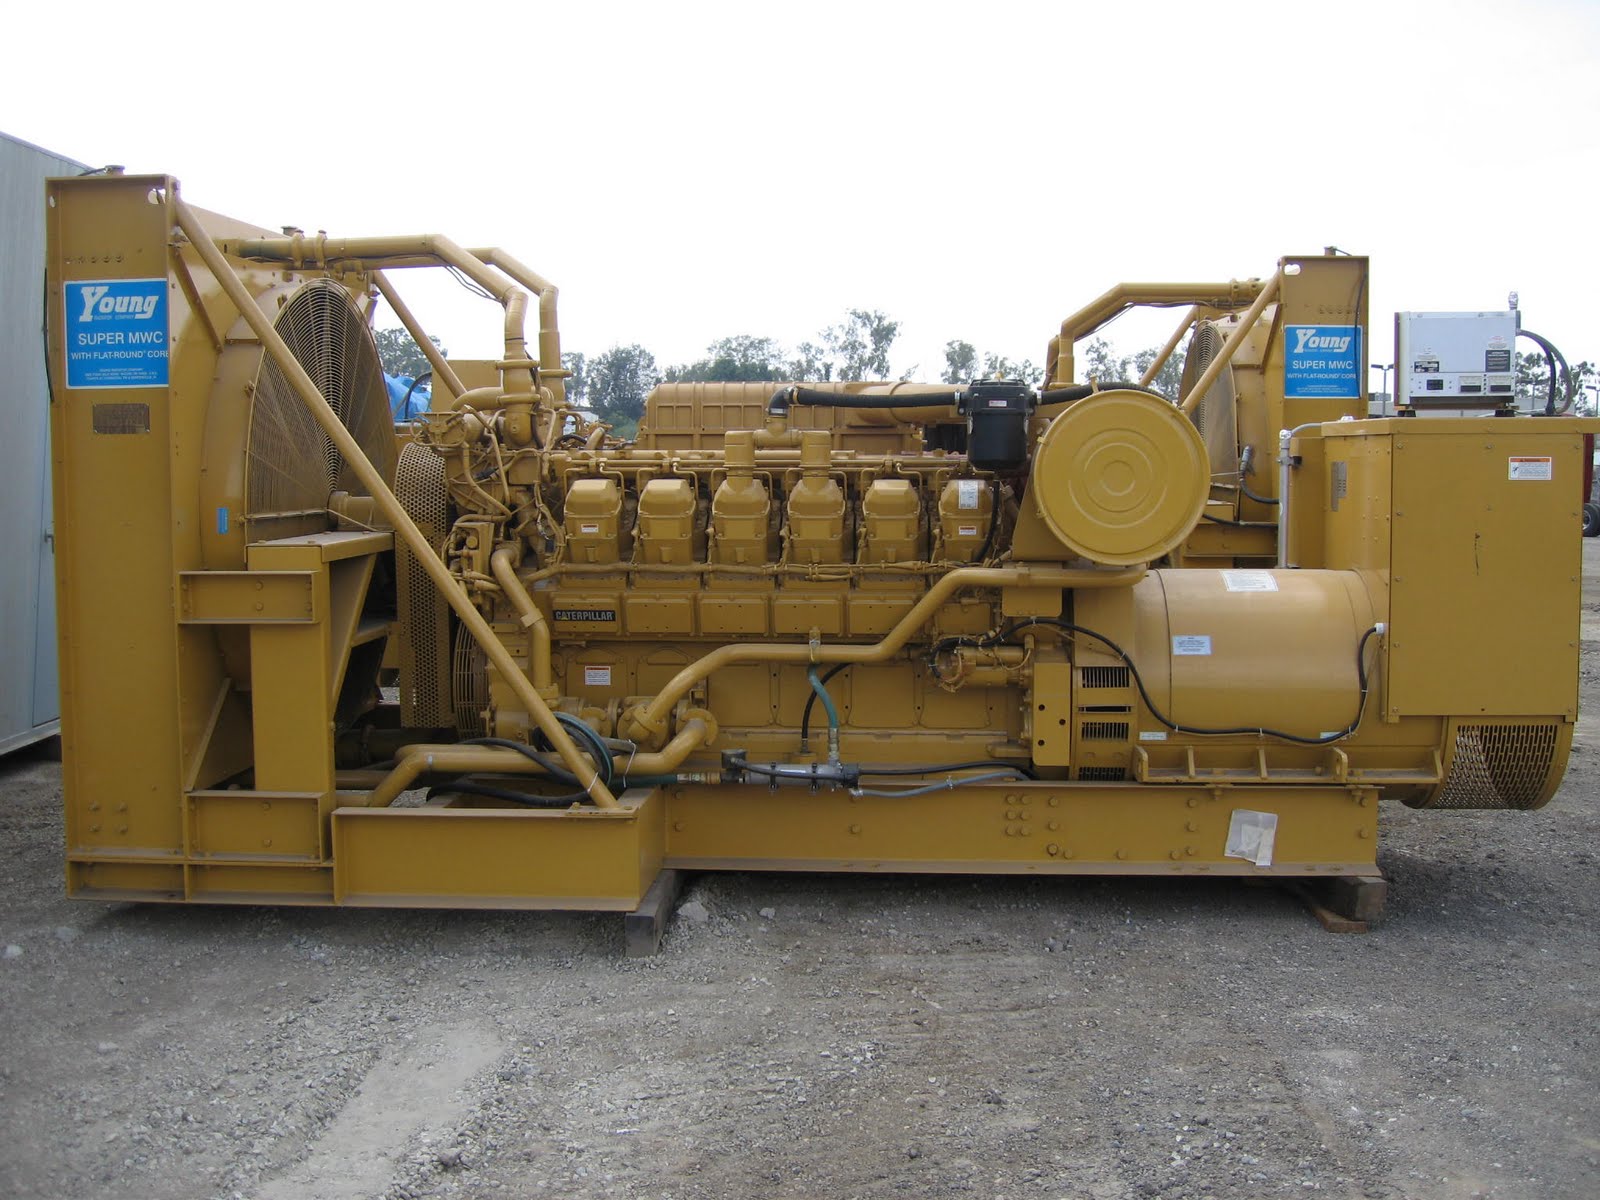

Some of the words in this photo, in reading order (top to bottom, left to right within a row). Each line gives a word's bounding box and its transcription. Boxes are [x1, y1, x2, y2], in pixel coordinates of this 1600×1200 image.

[79, 286, 159, 322] Young
[78, 332, 125, 345] SUPER
[128, 331, 163, 344] MWC
[1293, 329, 1351, 353] Young
[71, 352, 92, 360] WITH
[1292, 360, 1326, 369] SUPER
[1328, 360, 1353, 369] MWC
[555, 611, 613, 620] CATERPILLAR
